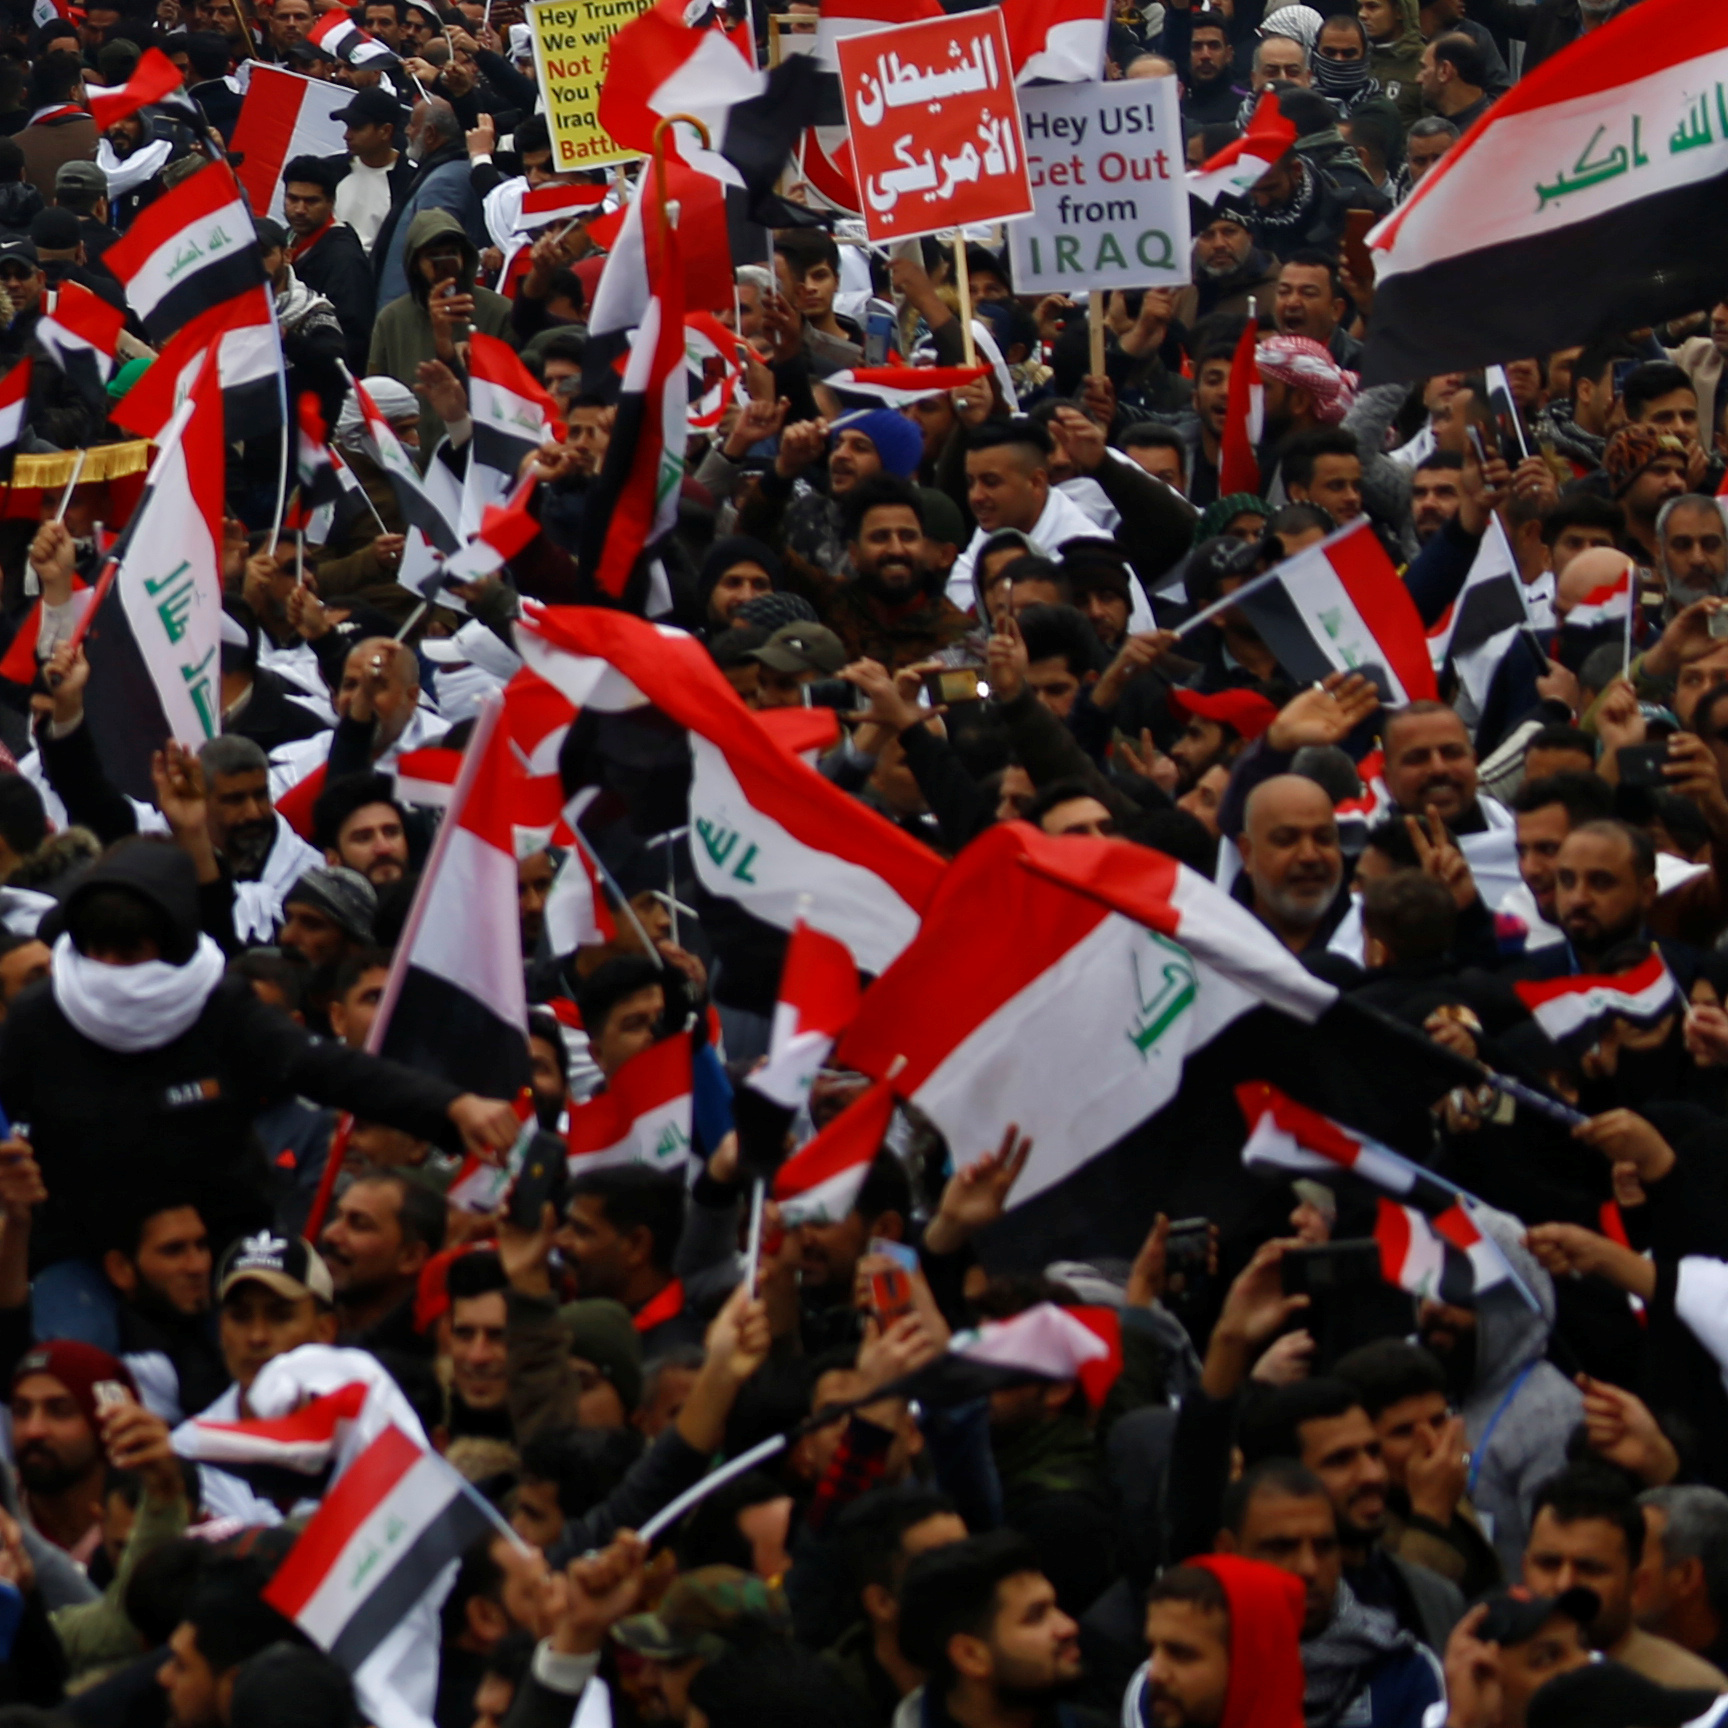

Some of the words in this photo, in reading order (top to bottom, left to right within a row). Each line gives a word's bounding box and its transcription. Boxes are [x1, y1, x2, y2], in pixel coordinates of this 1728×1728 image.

[538, 8, 578, 28] Hey
[542, 34, 577, 52] We
[547, 55, 593, 80] Not
[855, 33, 1000, 127] الشيطان
[551, 86, 589, 103] You
[556, 111, 596, 130] Iraq
[1026, 112, 1088, 146] Hey
[1098, 103, 1155, 136] US!
[865, 107, 1018, 224] الأمريكي
[1027, 153, 1086, 188] Get
[1097, 149, 1171, 184] Out
[1057, 195, 1138, 224] from
[1030, 229, 1177, 276] IRAQ
